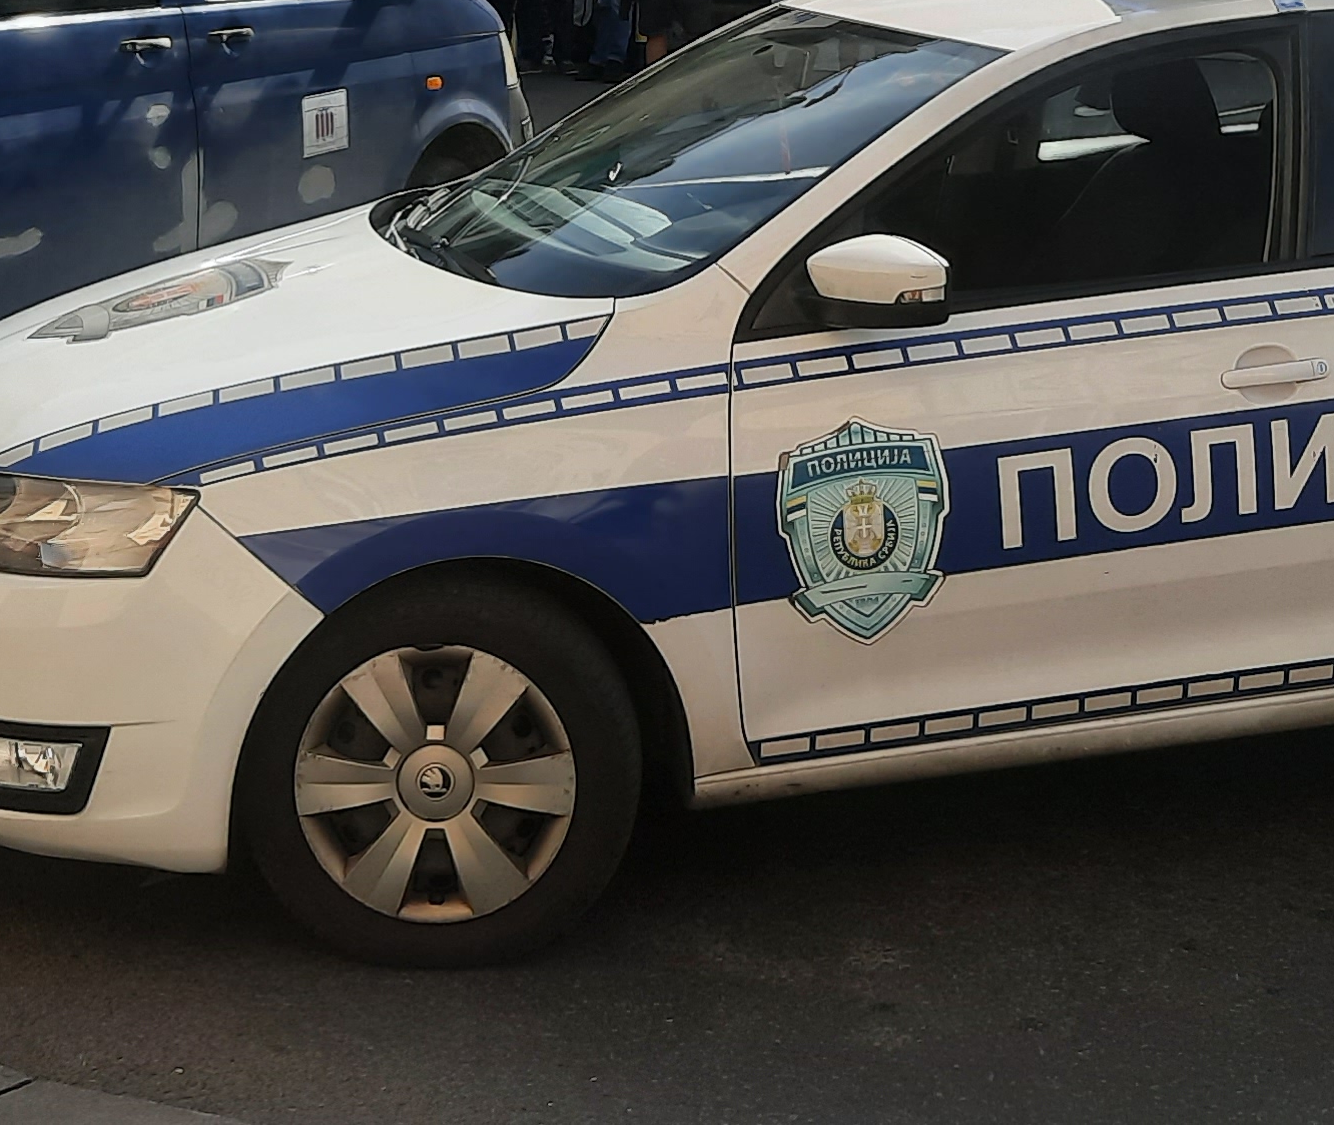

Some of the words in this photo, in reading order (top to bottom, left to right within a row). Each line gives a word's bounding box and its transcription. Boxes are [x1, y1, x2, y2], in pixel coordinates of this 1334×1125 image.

[807, 448, 911, 477] ПОЛИЦИЈА
[831, 527, 877, 569] РЕПУБЛИКА
[877, 519, 898, 559] СРБИЈА
